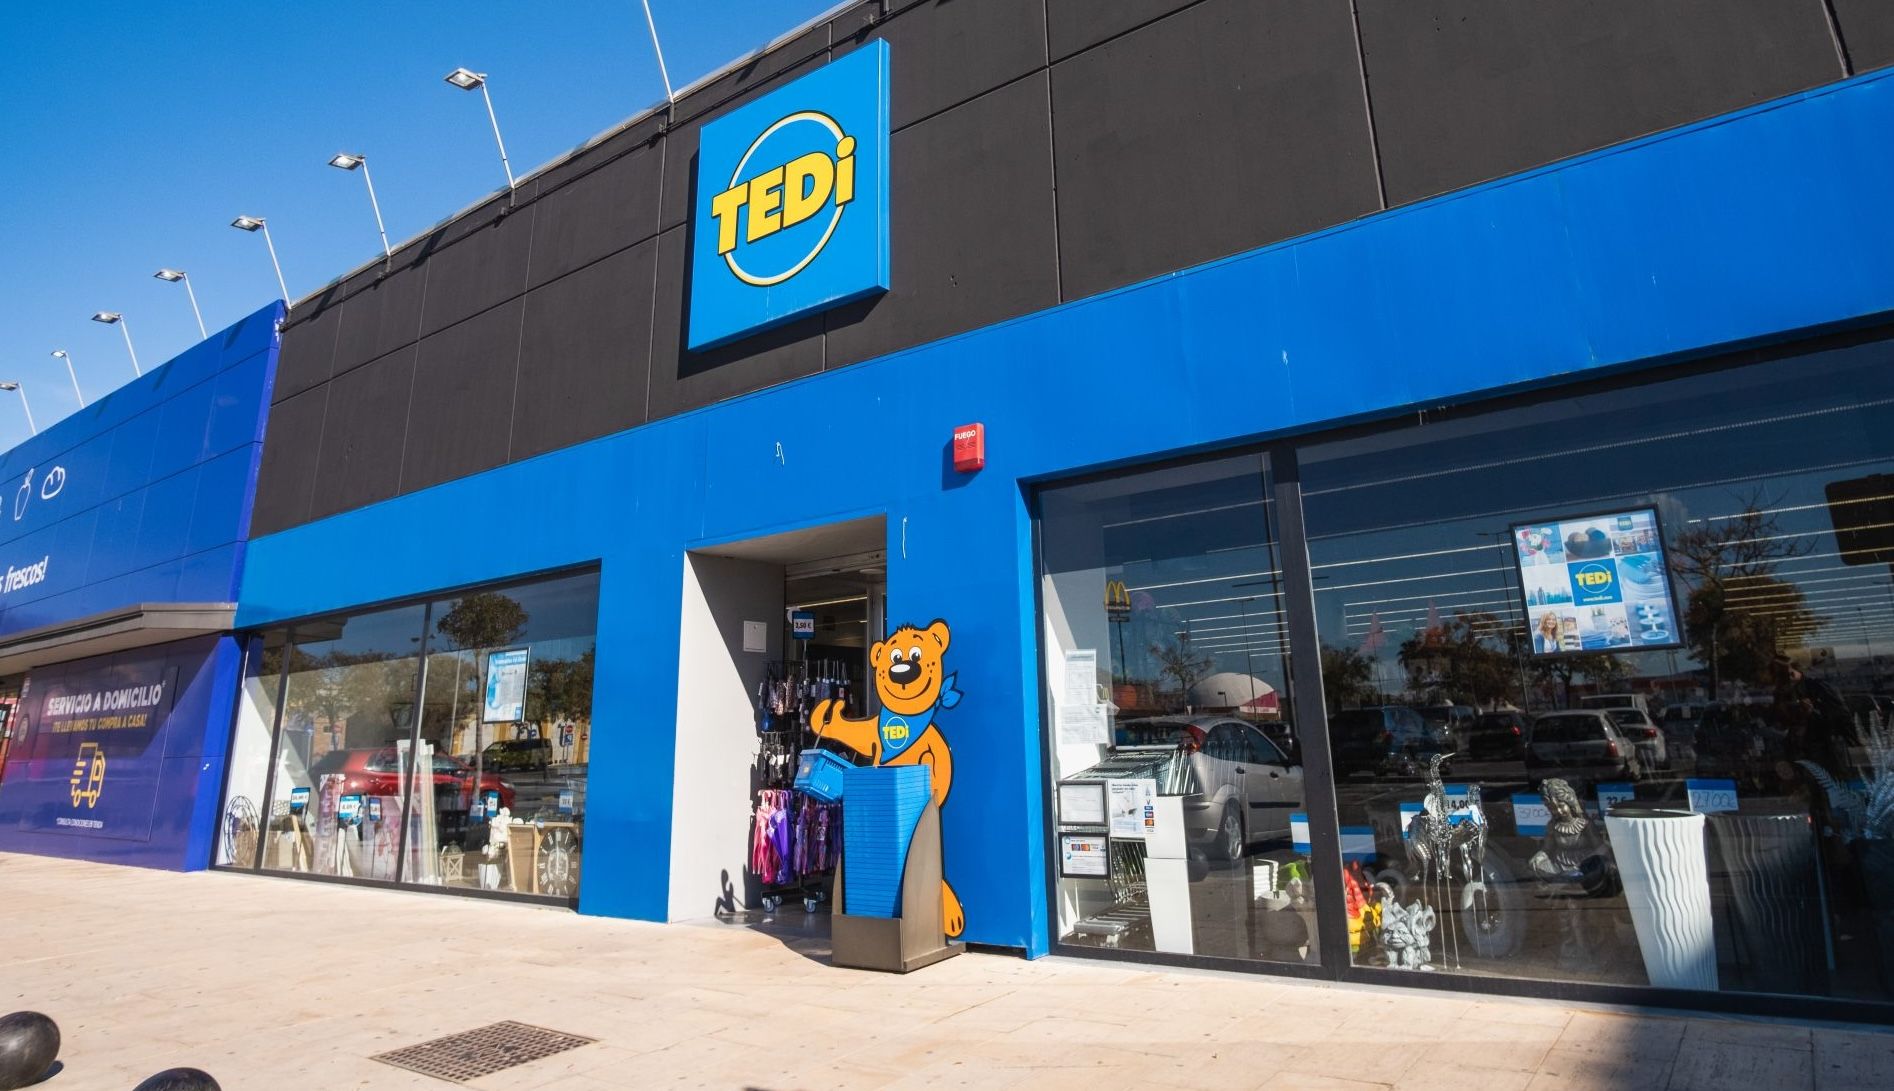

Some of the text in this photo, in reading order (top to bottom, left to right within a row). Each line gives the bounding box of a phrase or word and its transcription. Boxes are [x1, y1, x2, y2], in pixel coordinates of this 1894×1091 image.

[711, 135, 856, 256] TEDi
[954, 429, 976, 441] FUEGO
[4, 555, 49, 594] frescos!
[1575, 570, 1613, 586] TEDi
[47, 693, 92, 716] SERVICIO
[93, 692, 101, 712] A
[89, 718, 97, 730] TU
[97, 716, 121, 729] COMPRA
[121, 717, 127, 728] A
[127, 714, 148, 728] CASA!
[882, 725, 909, 740] TEDi
